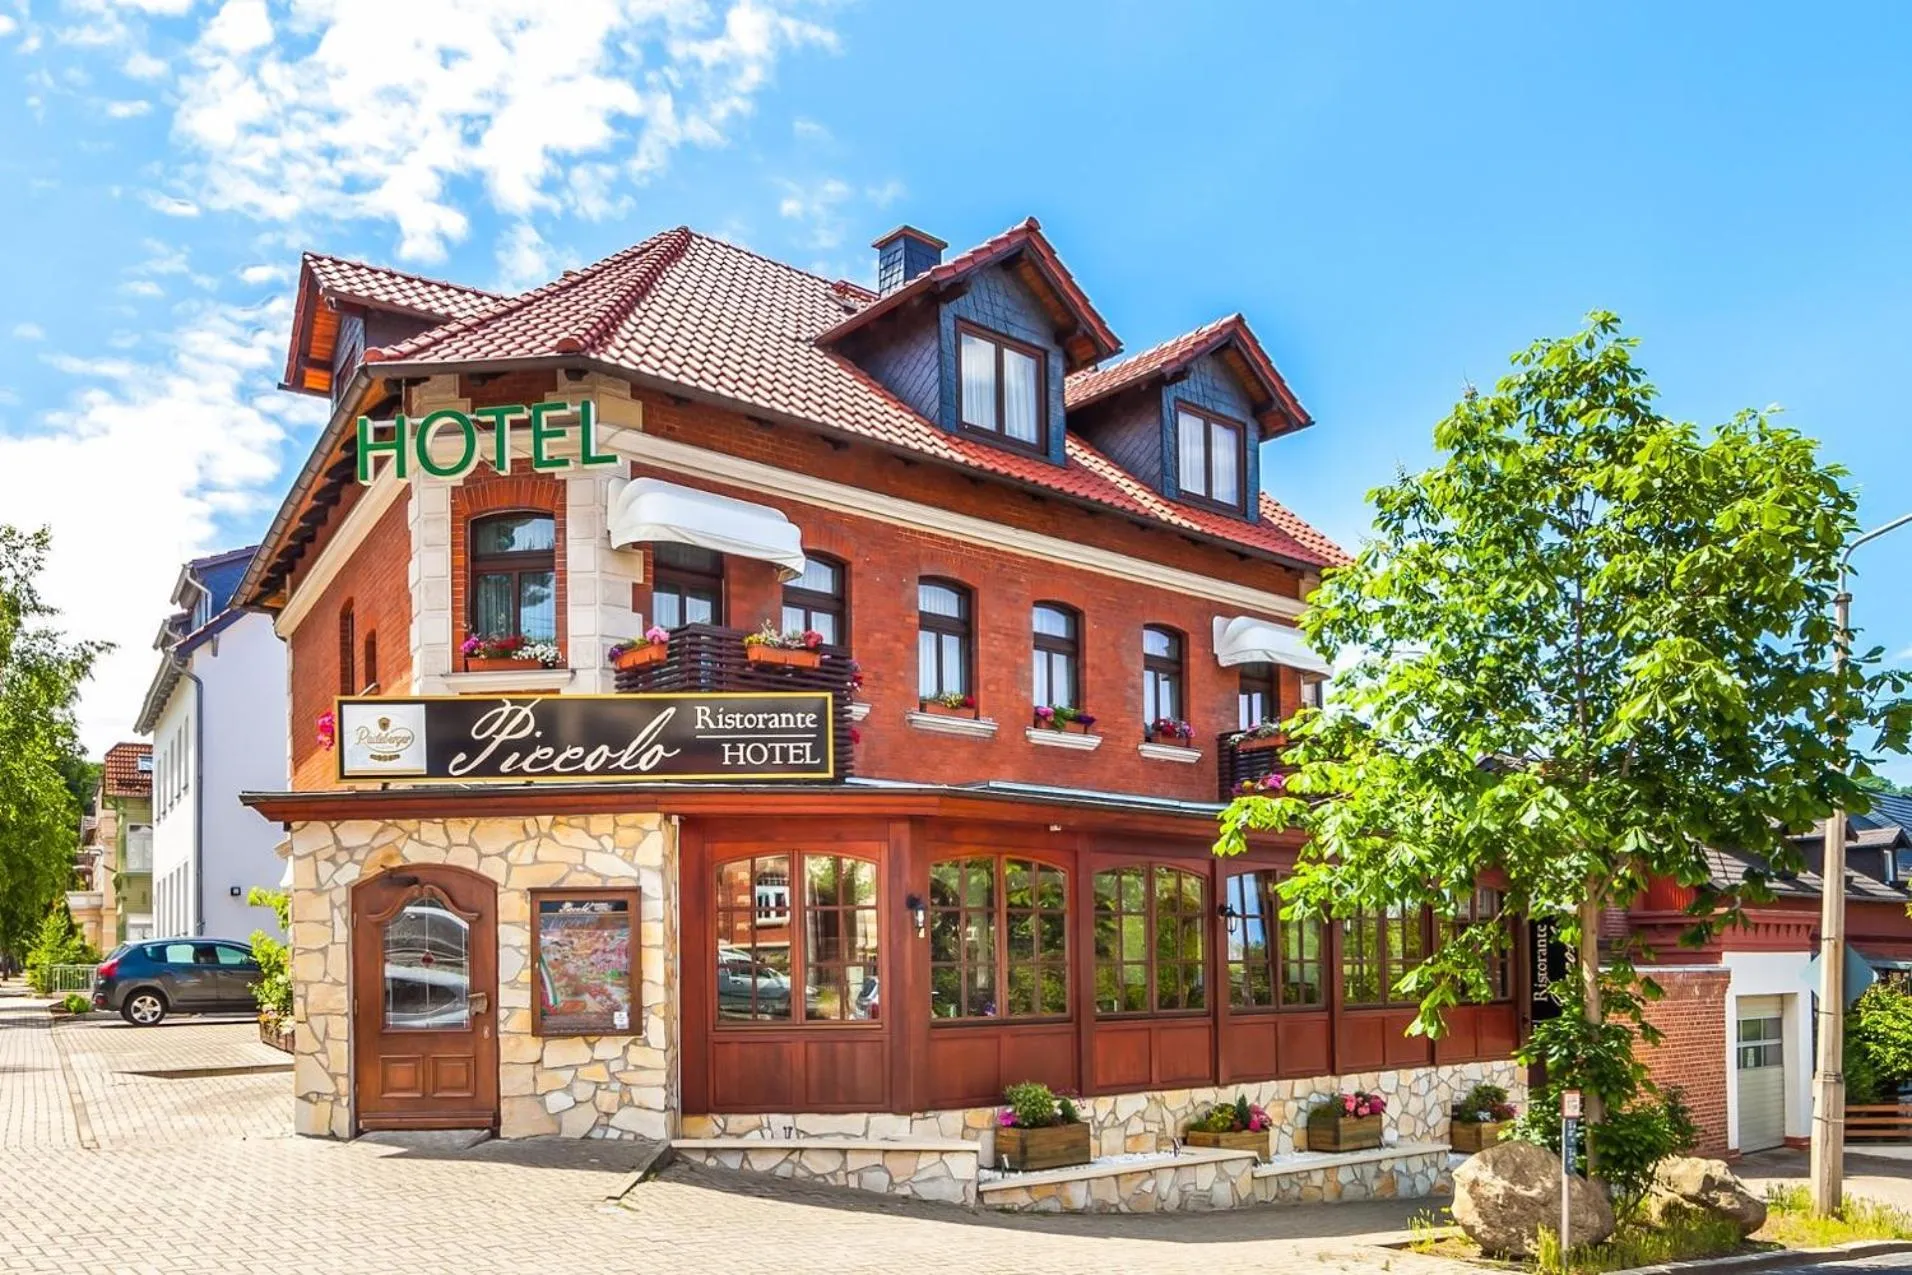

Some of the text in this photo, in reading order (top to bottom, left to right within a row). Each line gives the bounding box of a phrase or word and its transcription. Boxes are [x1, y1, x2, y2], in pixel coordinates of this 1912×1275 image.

[357, 400, 621, 486] HOTEL
[449, 697, 682, 776] Piccolo
[694, 706, 818, 730] Ristorante
[721, 742, 822, 766] HOTEL
[1533, 924, 1549, 1002] Ristorante
